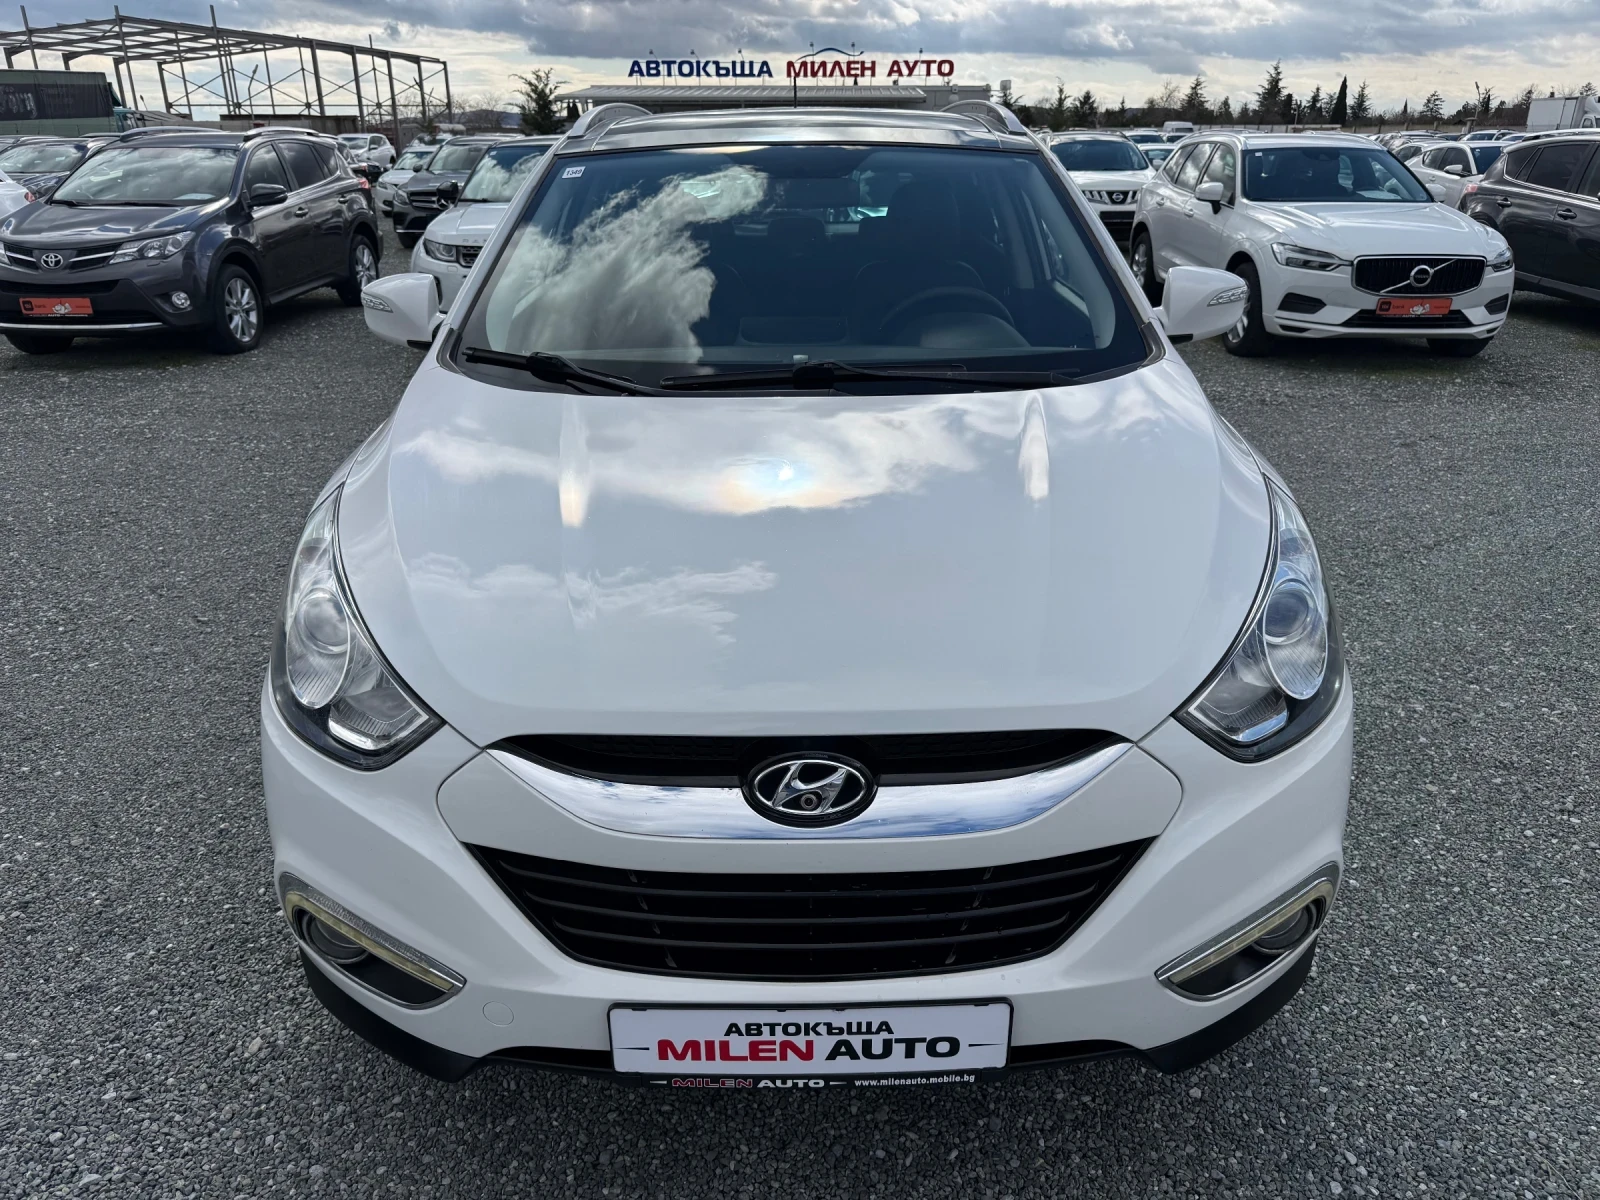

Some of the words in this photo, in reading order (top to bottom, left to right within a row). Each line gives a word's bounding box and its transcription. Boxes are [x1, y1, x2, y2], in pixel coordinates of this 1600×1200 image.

[628, 60, 773, 77] АВТОКЪЩА
[786, 60, 876, 77] МИЛЕН
[887, 60, 955, 77] АУТО
[724, 1021, 894, 1036] АВТОКЪЩА
[657, 1039, 814, 1061] MILEN
[825, 1036, 960, 1060] AUTO
[672, 1078, 753, 1088] MILEN
[757, 1078, 825, 1088] AUTO
[854, 1074, 975, 1087] www.milenauto.mobile.bg
